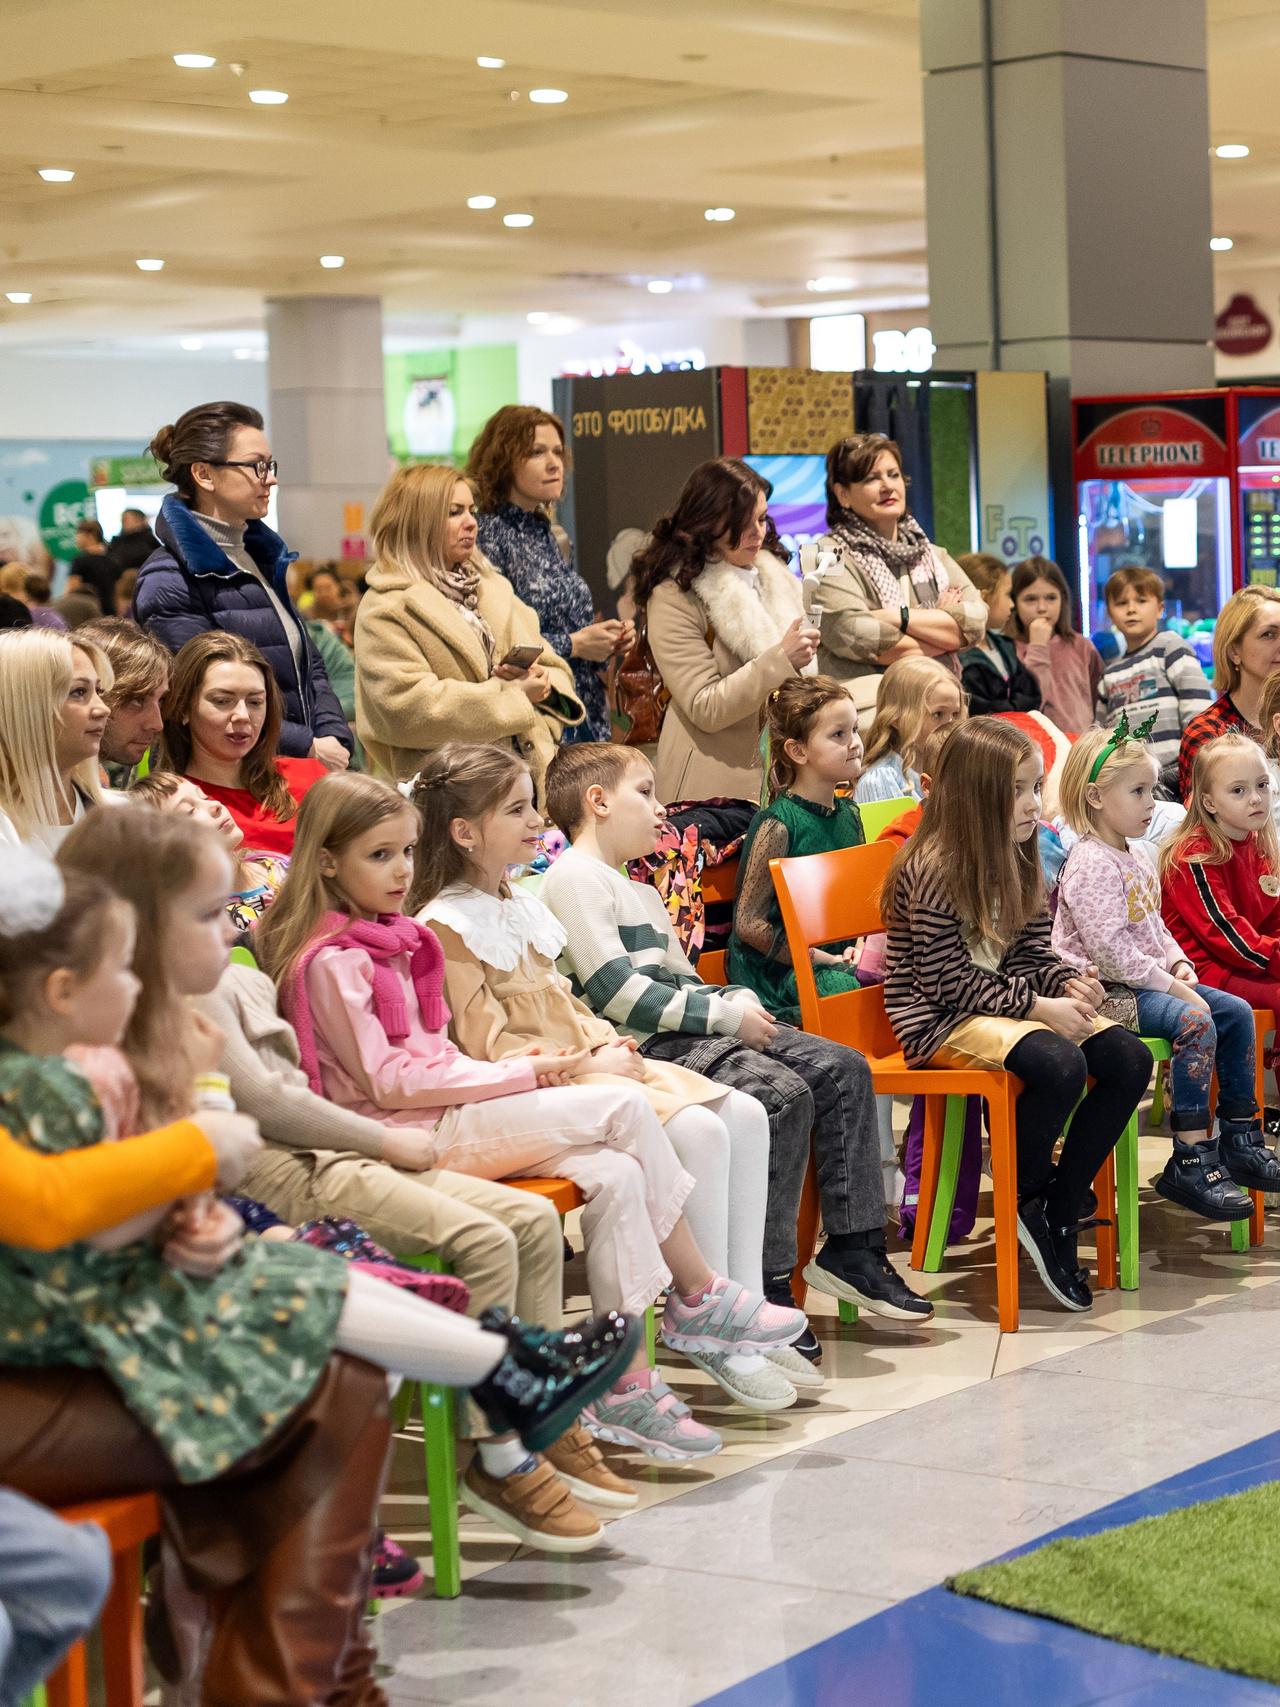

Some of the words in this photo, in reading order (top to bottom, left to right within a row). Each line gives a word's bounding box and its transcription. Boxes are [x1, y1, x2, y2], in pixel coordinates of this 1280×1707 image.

[573, 411, 602, 437] ЭТО
[607, 405, 707, 436] ФОТОБУДКА
[1097, 441, 1203, 466] TELEPHONE
